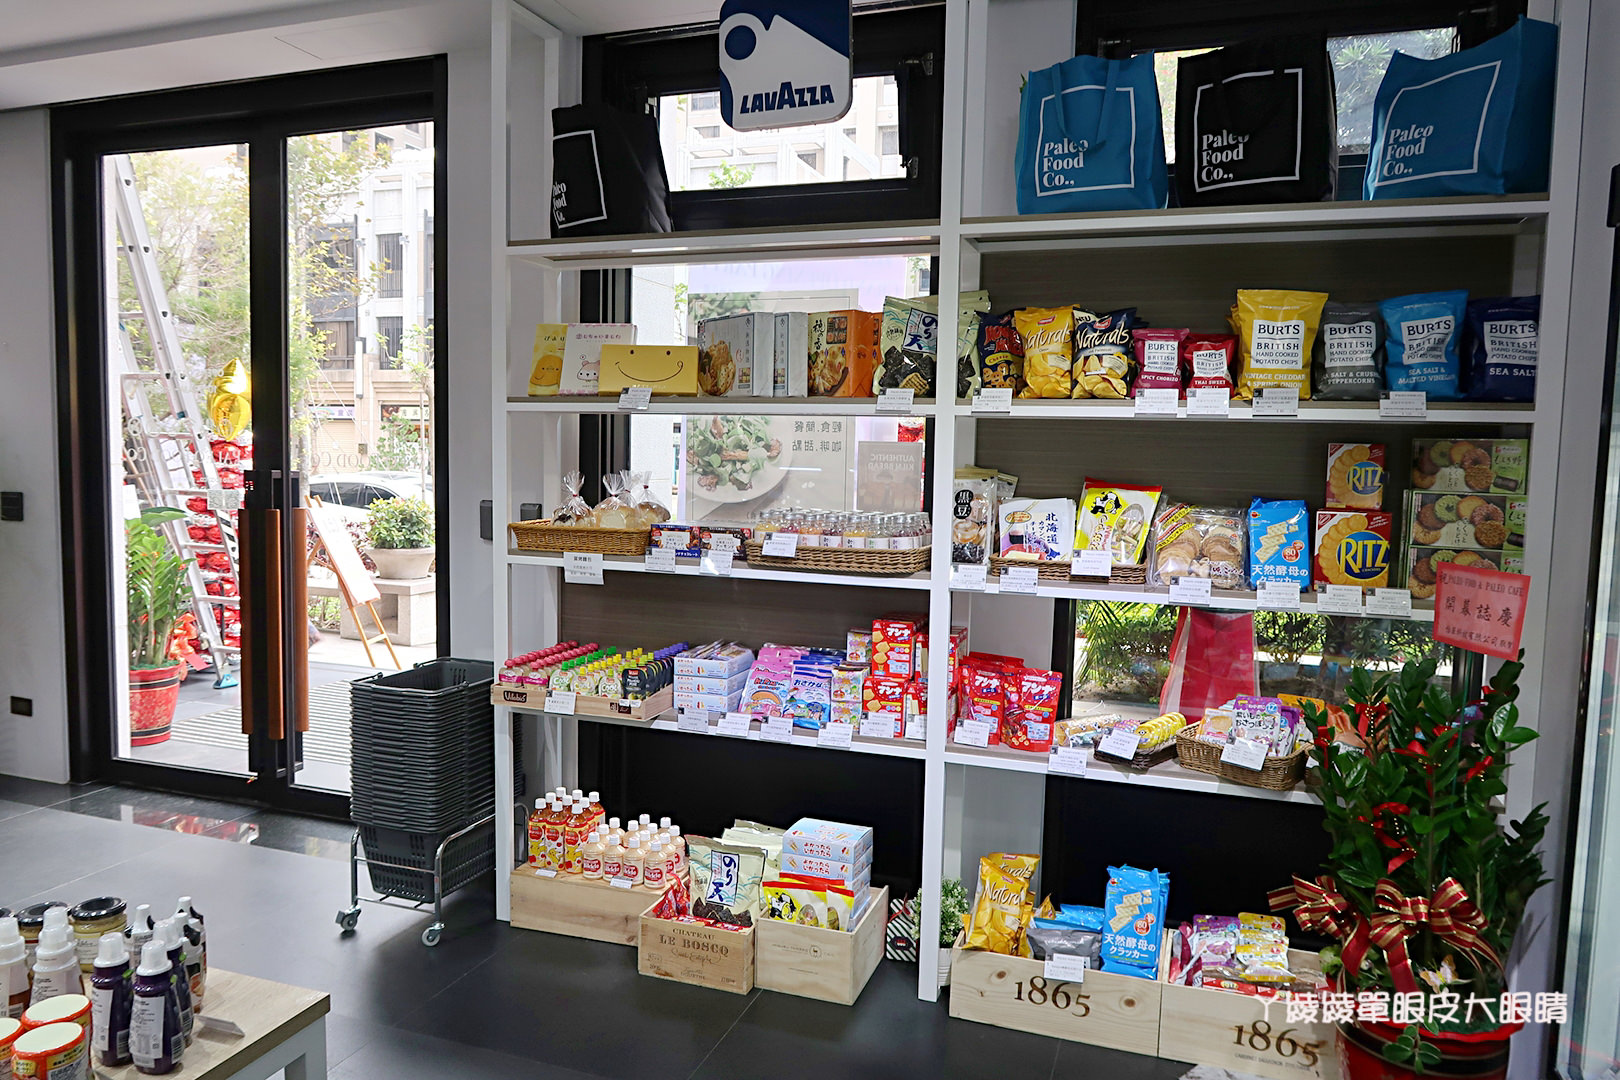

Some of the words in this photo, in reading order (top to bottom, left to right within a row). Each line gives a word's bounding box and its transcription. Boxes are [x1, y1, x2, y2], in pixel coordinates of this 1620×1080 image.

[740, 82, 835, 115] LAVAZZA
[1202, 143, 1244, 167] Food
[1385, 138, 1426, 161] Food
[1043, 153, 1084, 171] Food
[1076, 320, 1129, 349] Naturals
[1258, 324, 1300, 336] BURTS
[1329, 324, 1372, 336] BURTS
[1407, 319, 1451, 336] BURTS
[1489, 323, 1536, 335] BURTS
[1148, 343, 1175, 351] BURTS
[1256, 342, 1299, 350] BRITISH
[1490, 340, 1537, 348] BRITISH
[1274, 373, 1305, 381] CHEDDAR
[1489, 367, 1509, 375] SEA
[1350, 466, 1384, 490] RITZ
[1045, 512, 1059, 545] 北海道
[1340, 537, 1390, 574] RITZ
[1251, 564, 1309, 577] 天然酵母の
[672, 928, 715, 940] CHATEAU
[1104, 933, 1156, 952] 天然酵母の
[659, 934, 676, 946] LE
[683, 938, 729, 958] BOSCQ
[1110, 946, 1149, 958] クラッカー
[1014, 975, 1091, 1018] 1865
[1233, 1019, 1319, 1067] 1865
